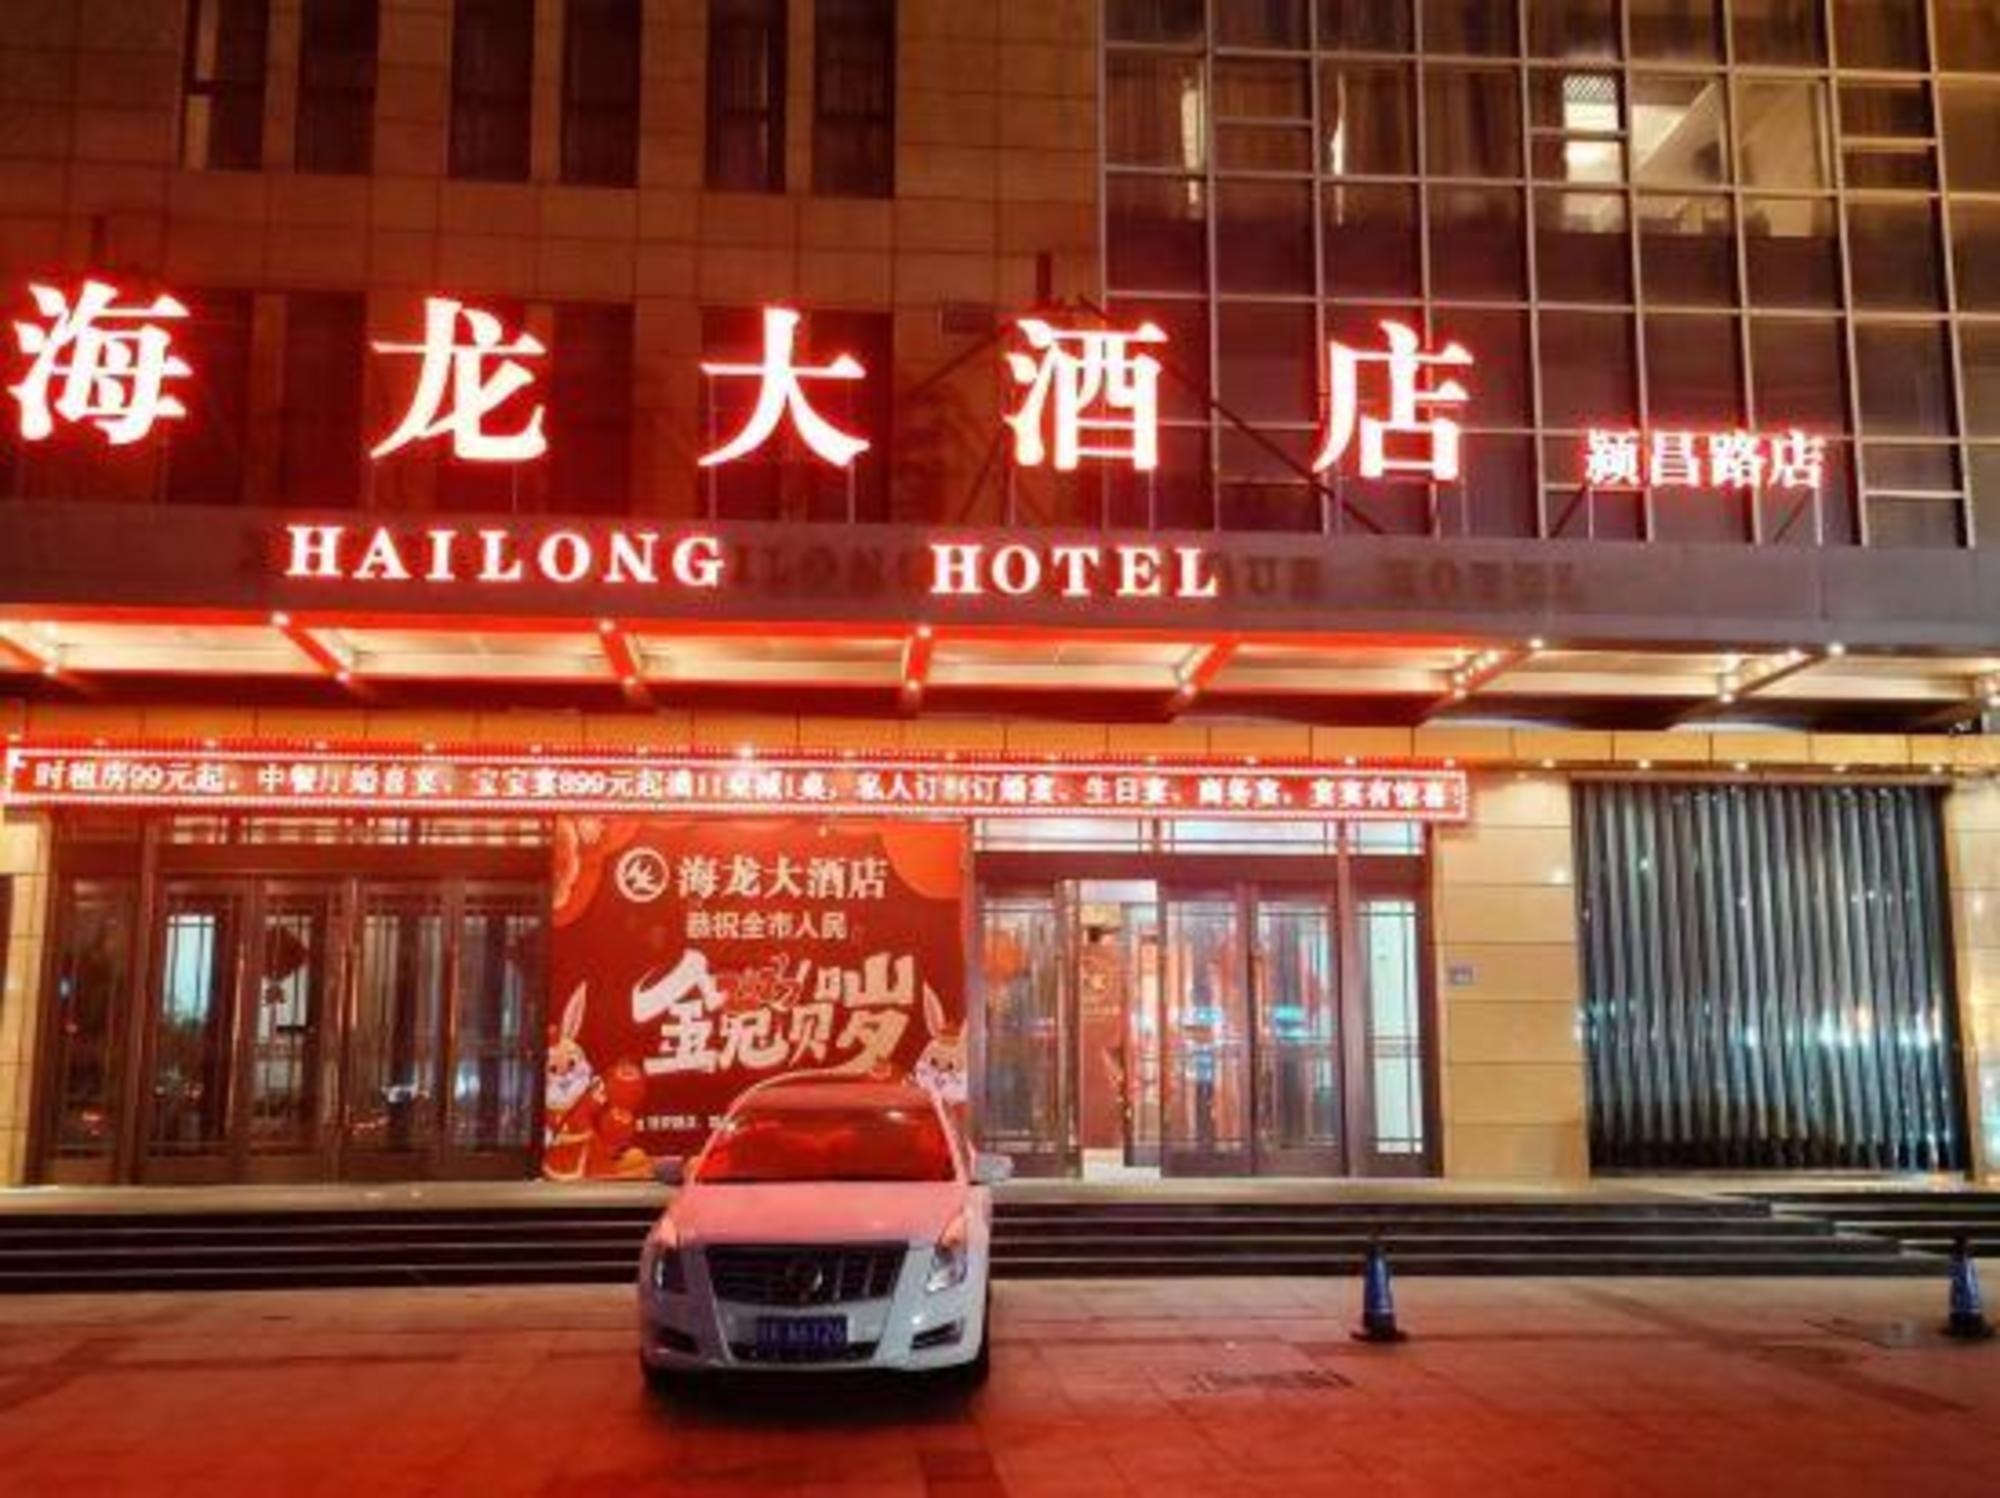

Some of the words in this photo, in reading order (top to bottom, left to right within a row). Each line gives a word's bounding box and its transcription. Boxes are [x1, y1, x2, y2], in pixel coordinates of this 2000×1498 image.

[8, 280, 1475, 481] 海龙大酒店
[286, 524, 727, 588] HAILONG
[931, 542, 1221, 599] HOTEL
[678, 854, 888, 898] 海龙大酒店
